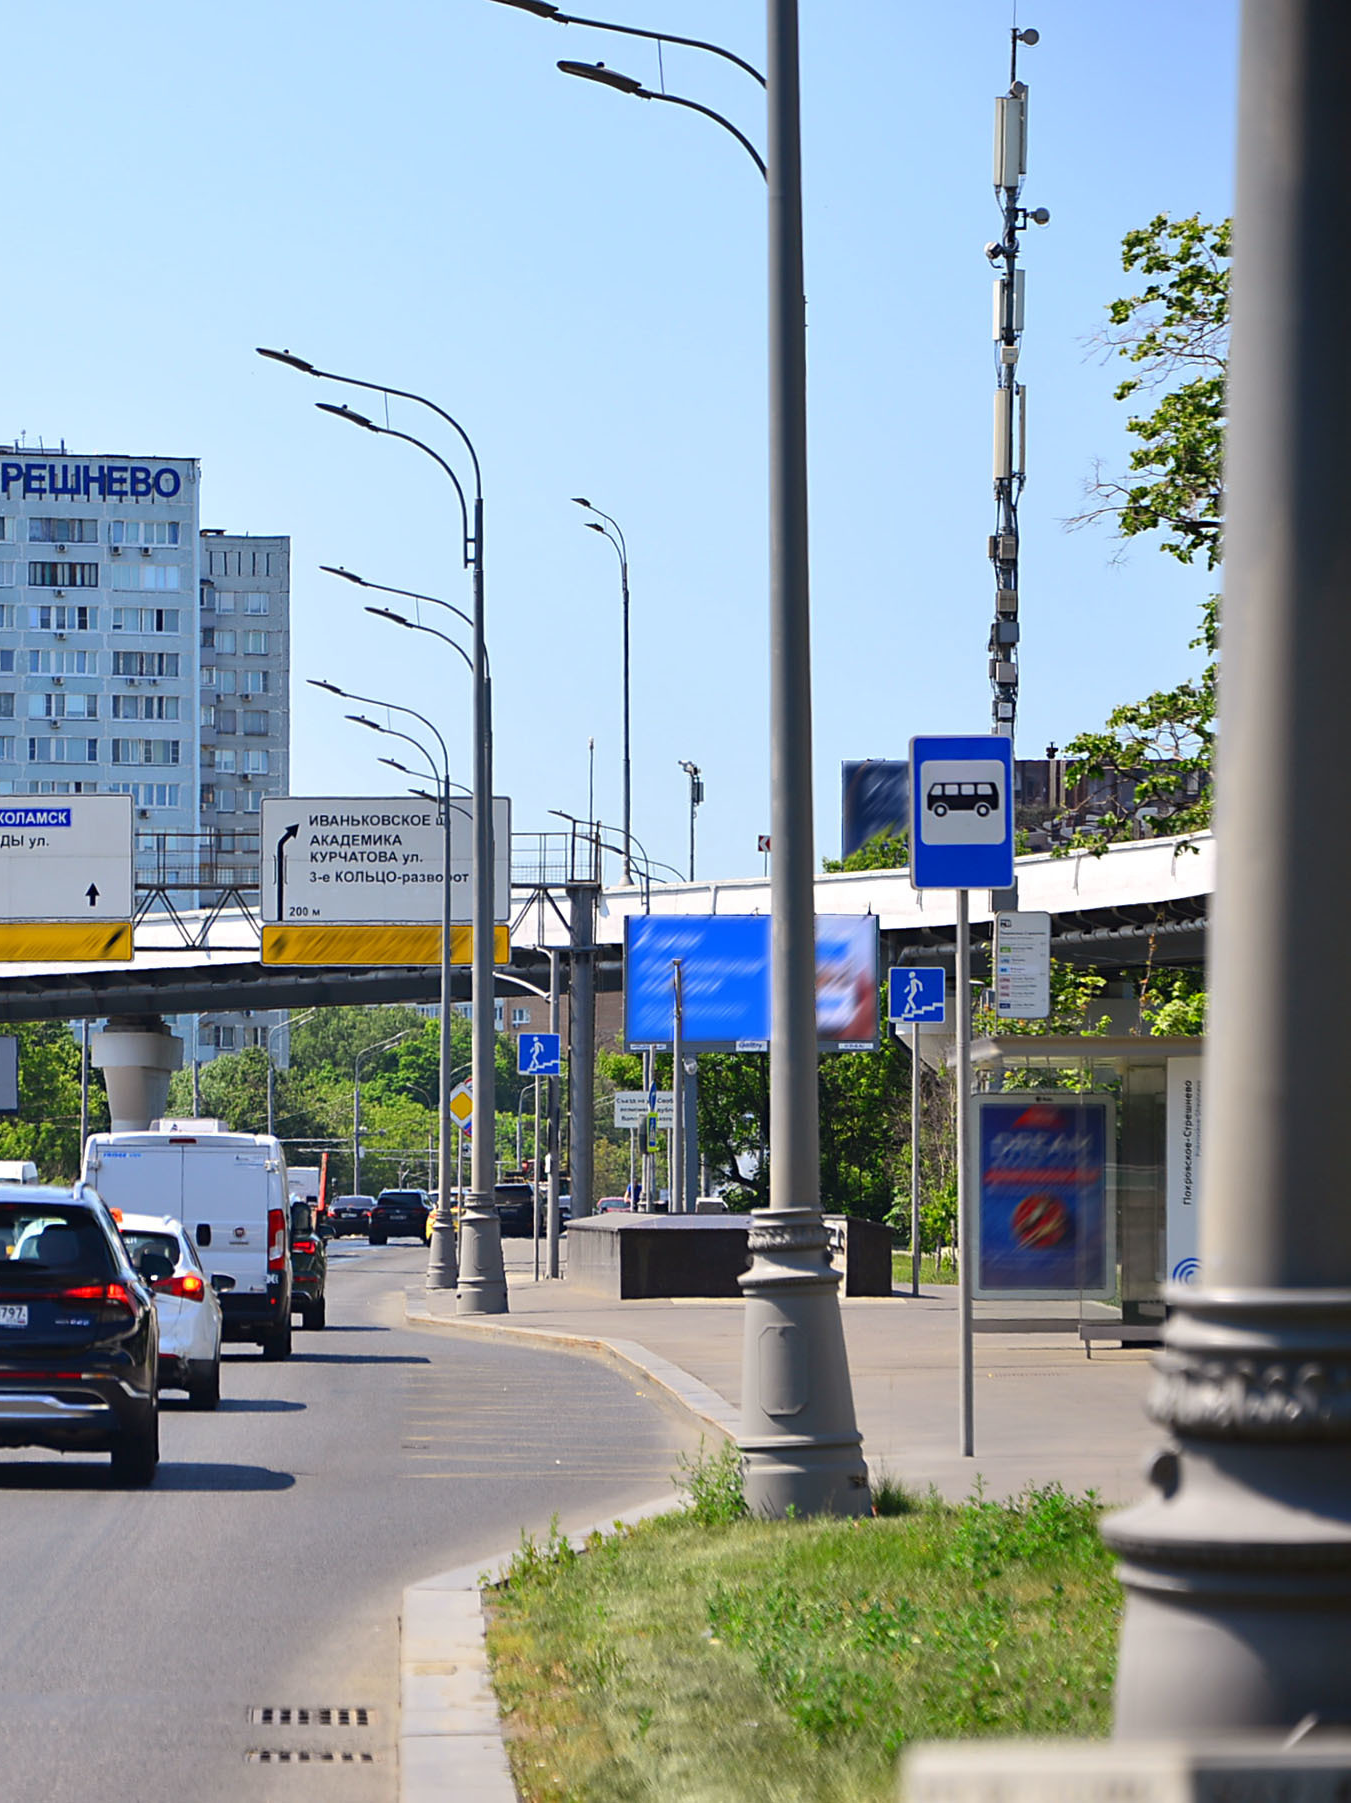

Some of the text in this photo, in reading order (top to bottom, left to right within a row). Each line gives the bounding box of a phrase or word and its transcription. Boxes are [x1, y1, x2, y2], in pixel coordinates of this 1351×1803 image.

[309, 814, 431, 826] ИВАНЬКОВСКОЕ
[29, 838, 50, 850] ул.
[310, 834, 403, 848] АКАДЕМИКА
[310, 851, 424, 865] КУРЧАТОВА ул.
[309, 870, 470, 885] 3-е КОЛЬЦО-развоот
[289, 906, 321, 917] 200 м
[1182, 1080, 1193, 1206] Покровское-Стрешнево
[0, 1307, 24, 1319] 797
